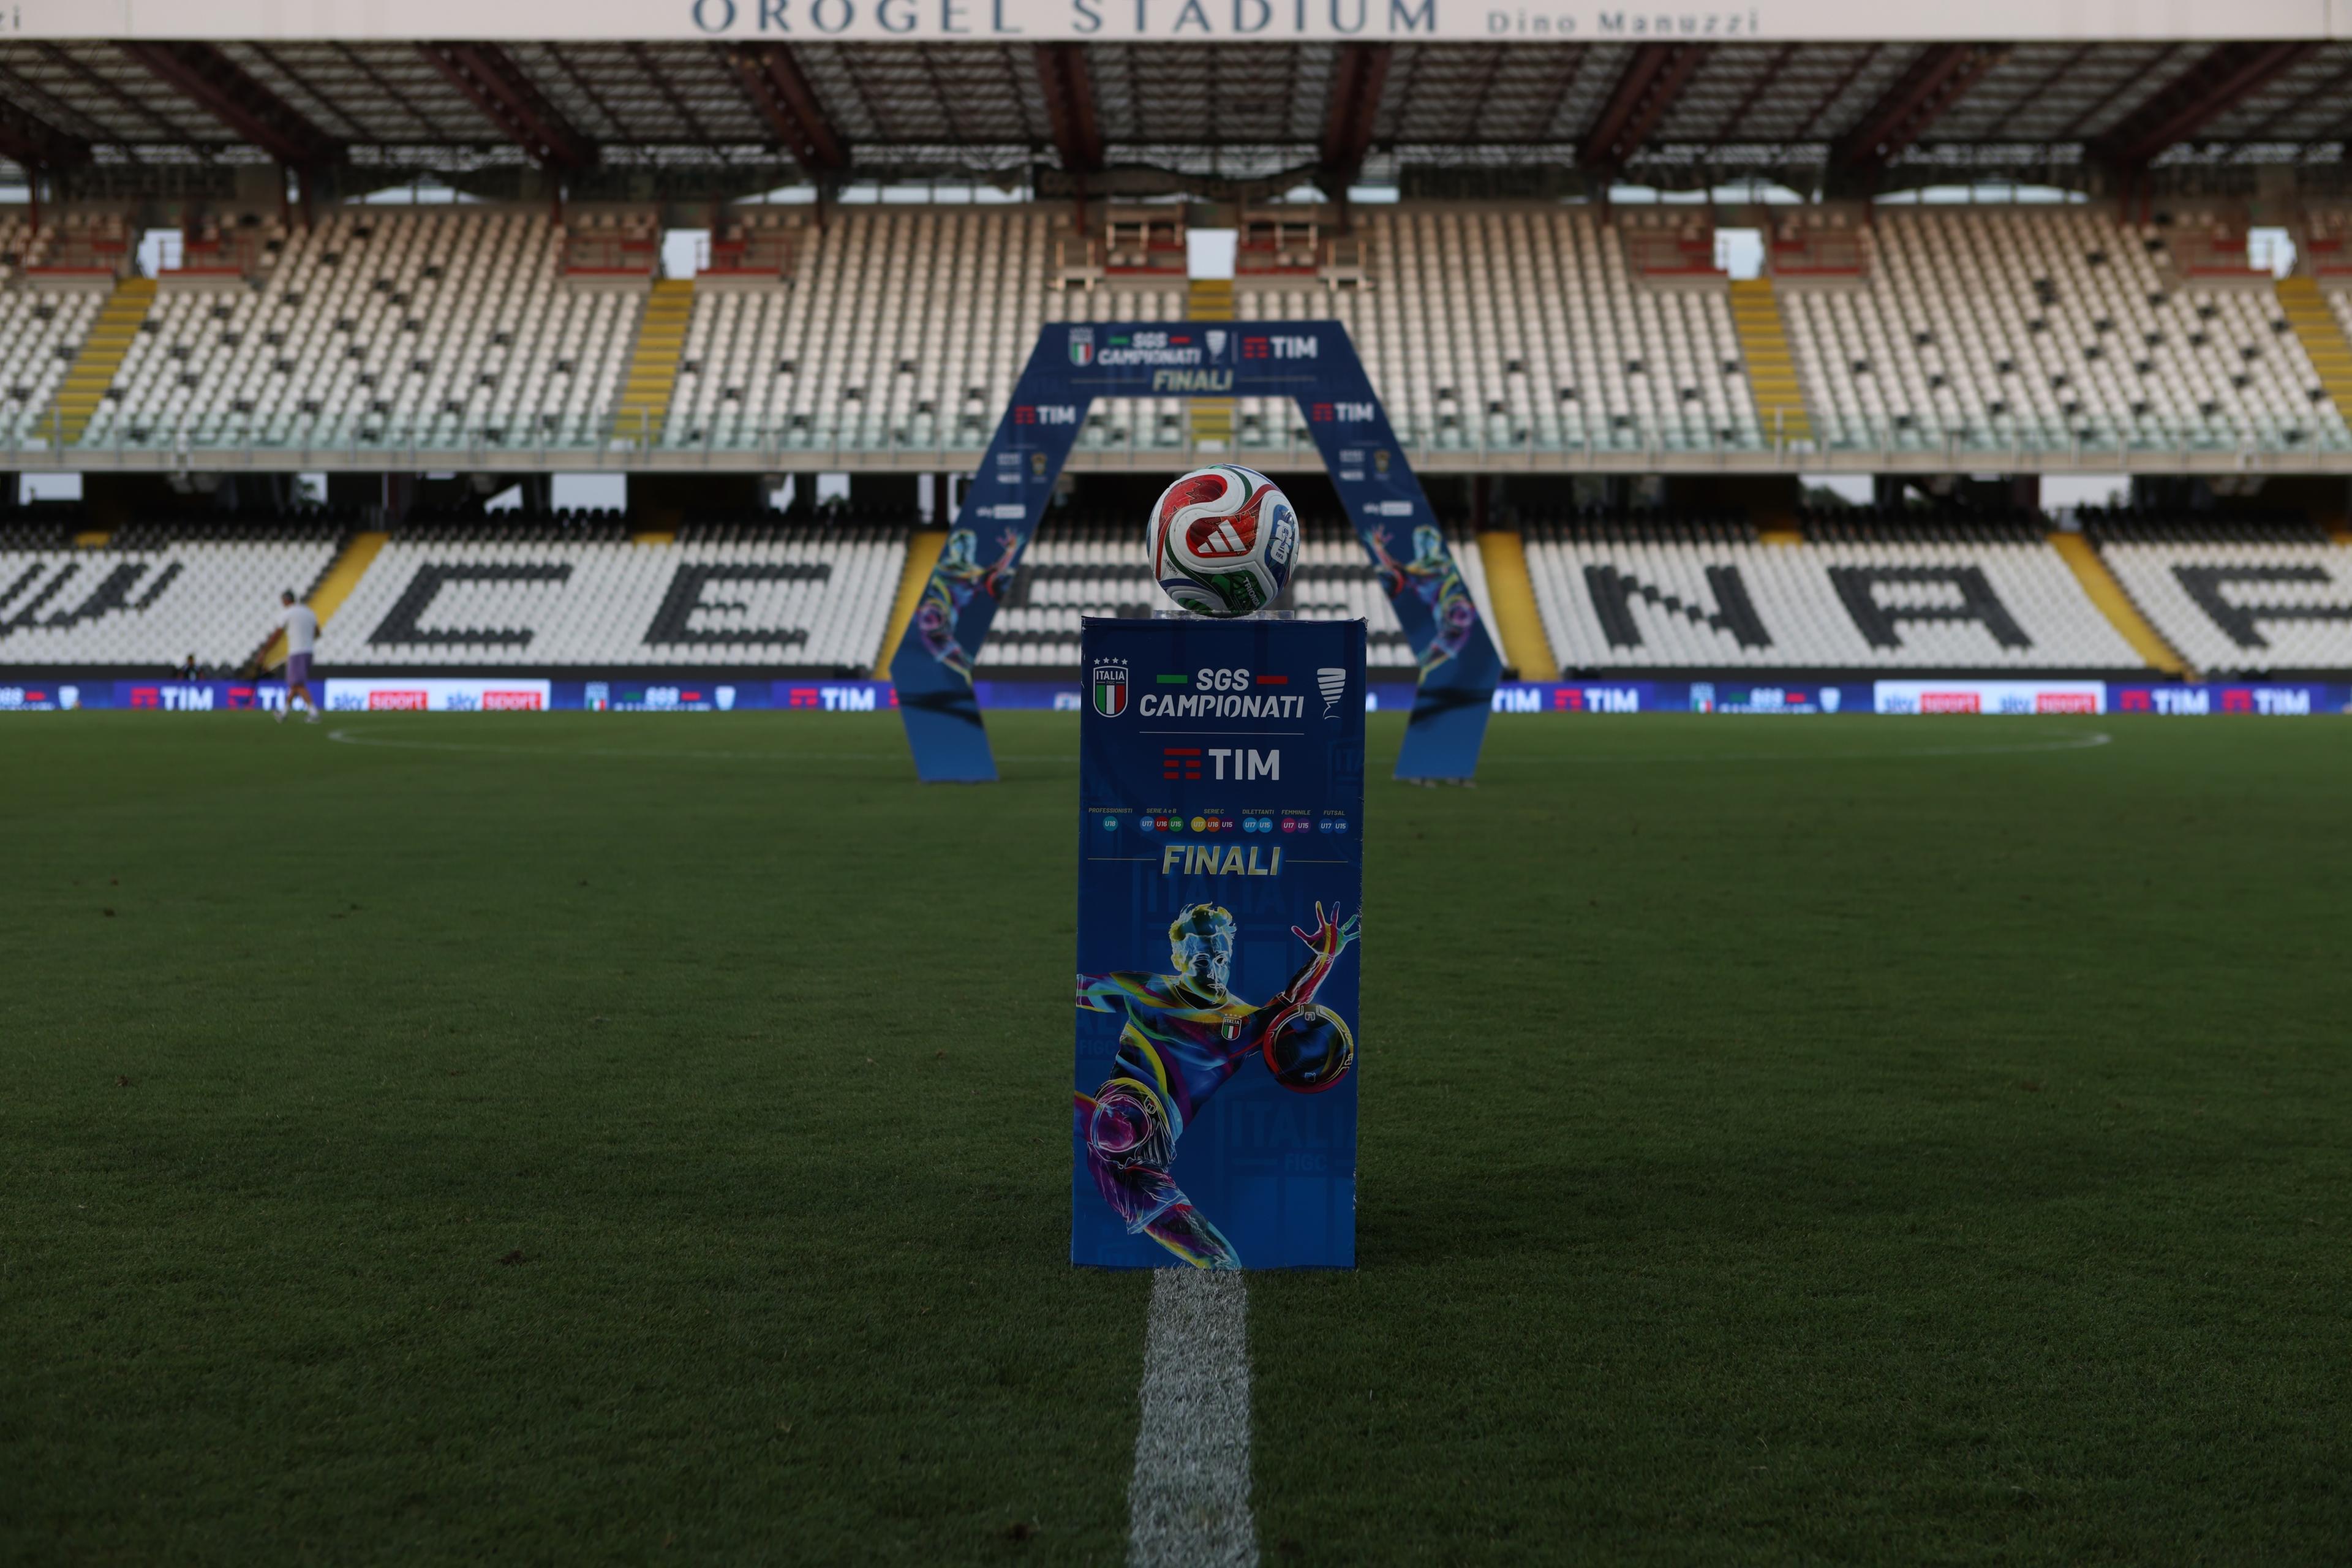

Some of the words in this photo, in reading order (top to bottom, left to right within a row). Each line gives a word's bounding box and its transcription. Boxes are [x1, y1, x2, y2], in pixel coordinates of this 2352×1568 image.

[692, 0, 1023, 33] OROGEL
[1487, 10, 1577, 34] Dino
[1598, 11, 1758, 34] Manuzzi
[1133, 332, 1167, 349] SGS
[1271, 336, 1318, 359] TIM
[1098, 348, 1202, 366] CAMPIONATI
[1152, 369, 1234, 391] FINALI
[1036, 405, 1076, 424] TIM
[1335, 402, 1375, 422] TIM
[1096, 671, 1125, 680] ITALIA
[1196, 668, 1250, 692] SGS
[160, 686, 214, 711] TIM
[258, 686, 307, 711] TI
[821, 687, 875, 712] TIM
[1139, 694, 1305, 718] CAMPIONATI
[1585, 688, 1639, 713] TIM
[2152, 688, 2209, 714] TIM
[2253, 688, 2310, 714] TIM
[1208, 748, 1280, 781] TIM
[1162, 845, 1281, 876] FINALI
